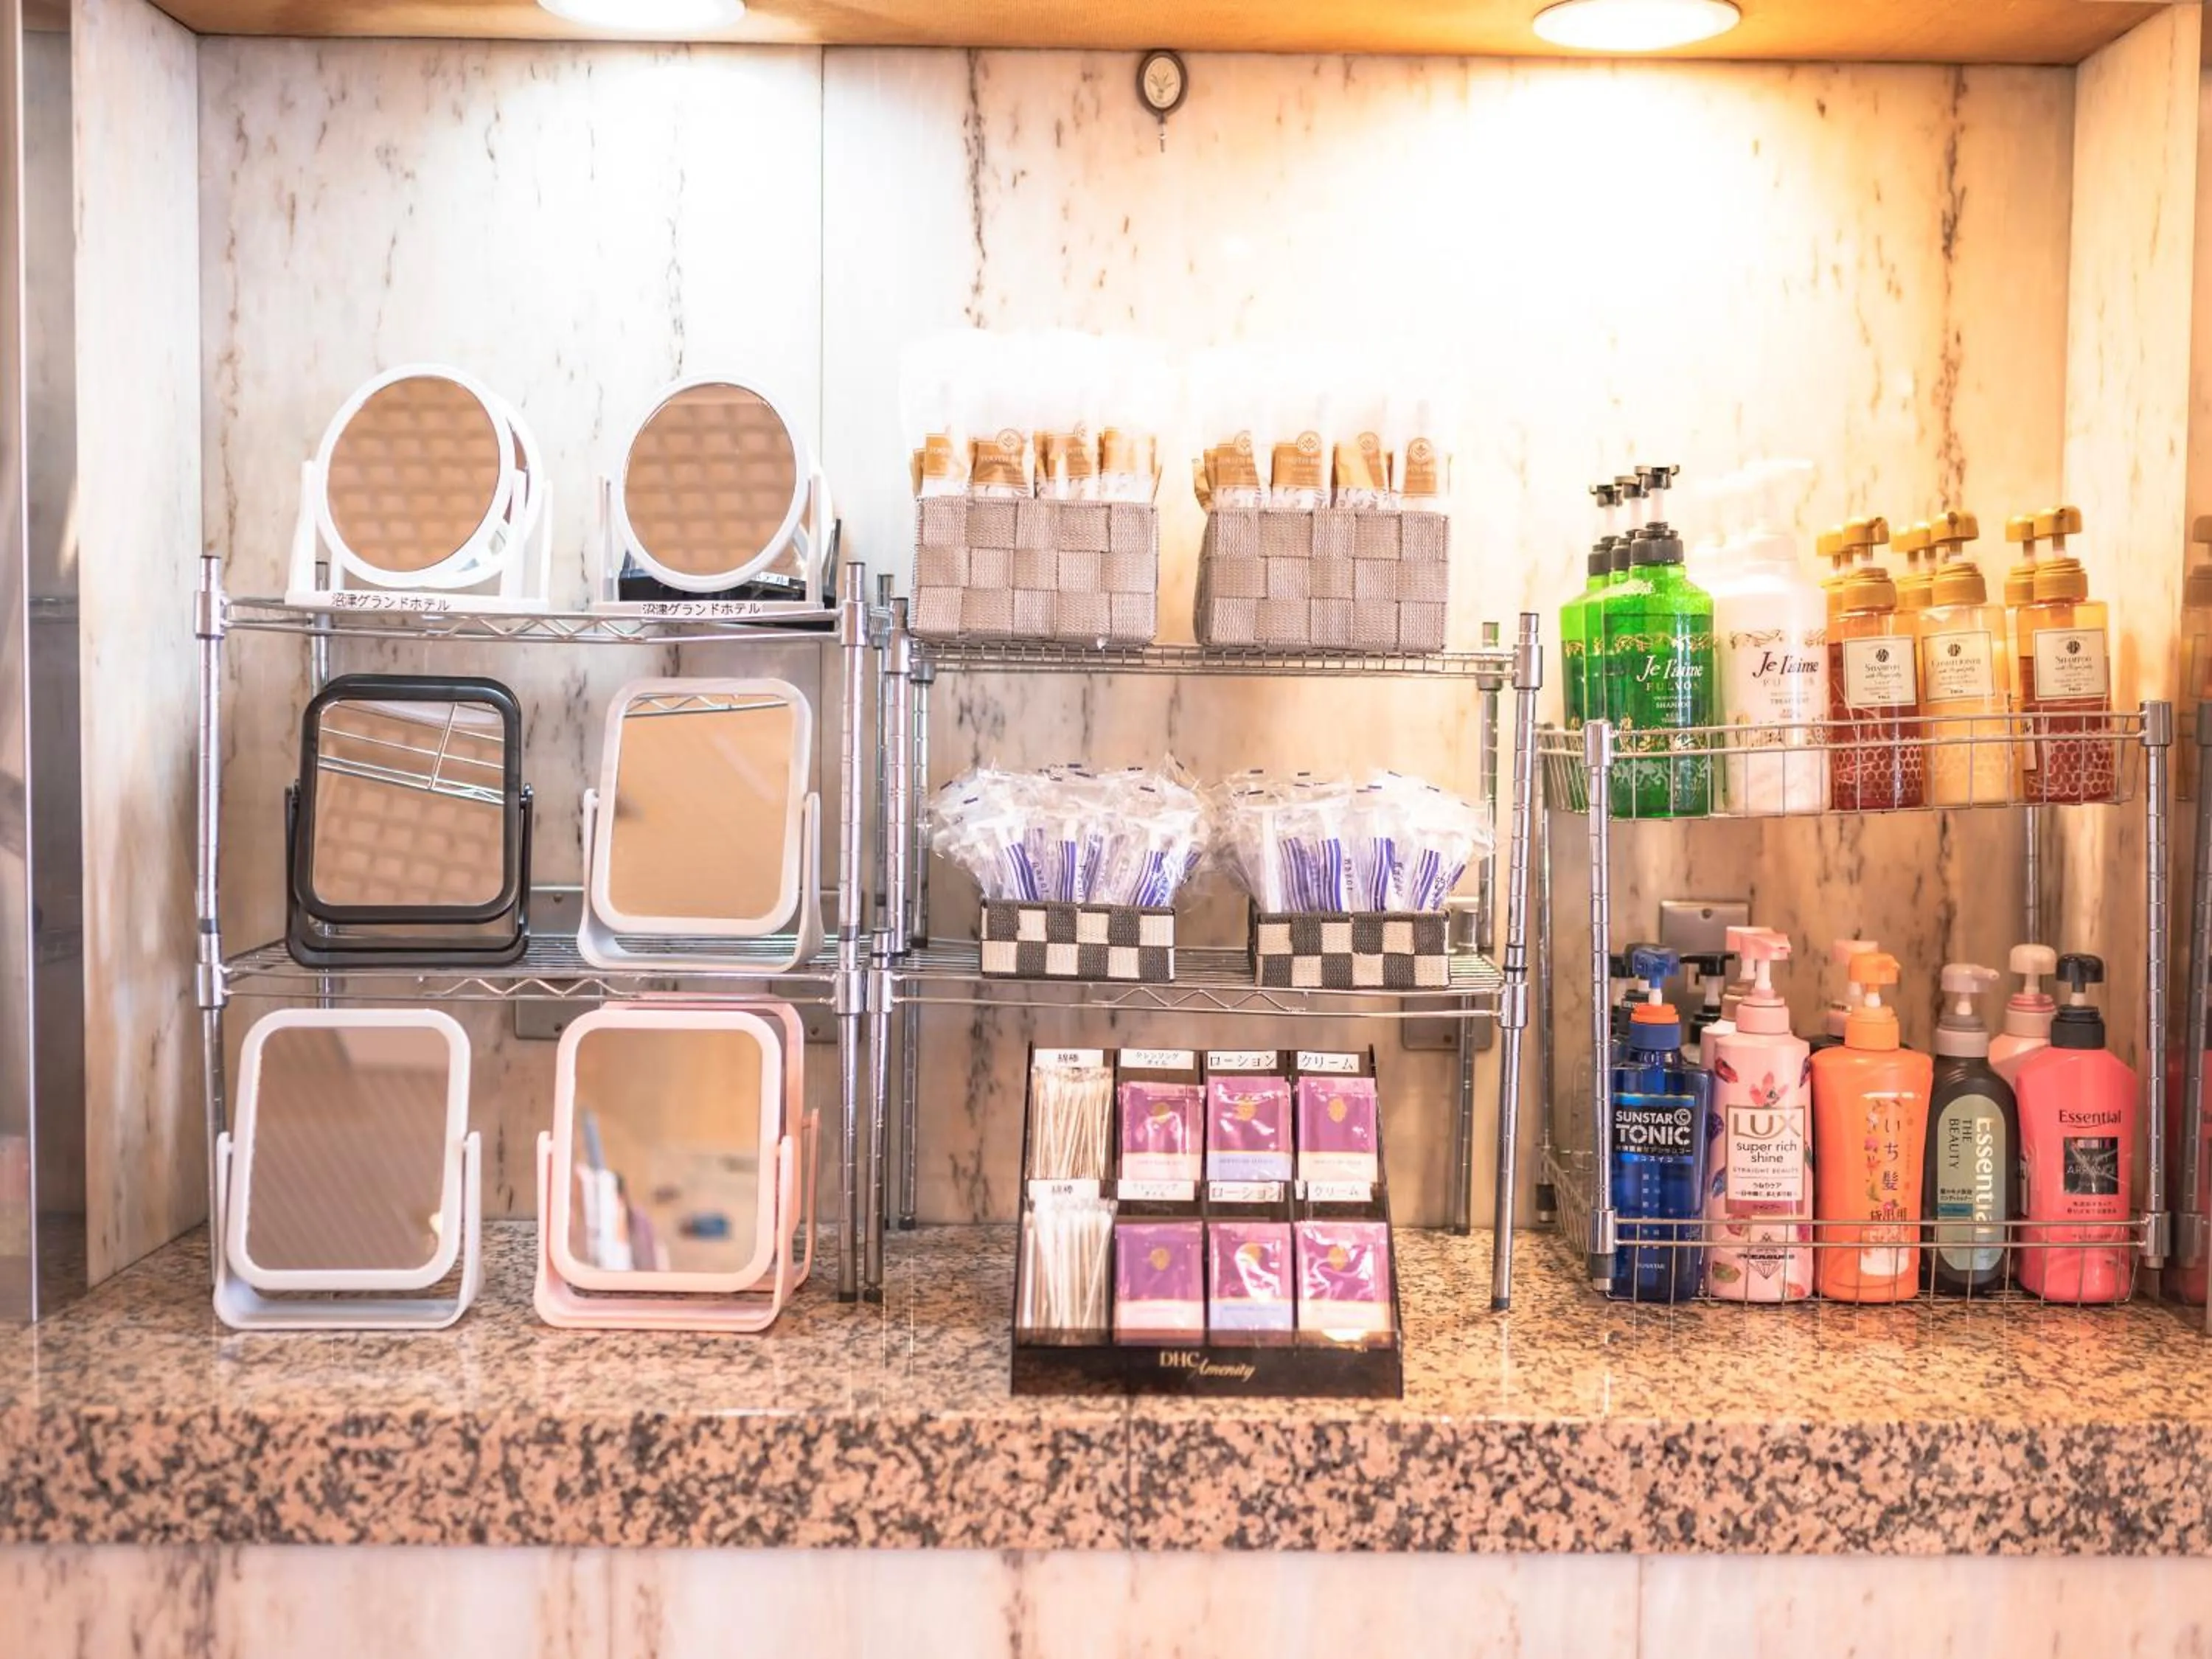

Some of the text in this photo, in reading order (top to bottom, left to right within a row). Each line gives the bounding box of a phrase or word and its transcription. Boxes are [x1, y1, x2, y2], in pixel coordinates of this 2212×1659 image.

[332, 592, 451, 611] 沼津グランドホテル
[642, 602, 760, 615] 沼津グランドホテル
[1636, 655, 1661, 682] Je
[1752, 651, 1778, 678] Je
[1210, 1054, 1275, 1068] ローション
[1301, 1054, 1354, 1070] クリーム
[1615, 1110, 1673, 1124] SUNSTAR
[2059, 1109, 2122, 1124] Essential
[1615, 1124, 1691, 1145] TONIC
[1733, 1113, 1801, 1140] LUX
[1962, 1119, 1972, 1143] THE
[1736, 1140, 1797, 1153] super rich
[1949, 1119, 1960, 1169] BEAUTY
[1751, 1152, 1784, 1163] shine
[1883, 1119, 1900, 1192] いち髪
[1159, 1350, 1200, 1368] DHC
